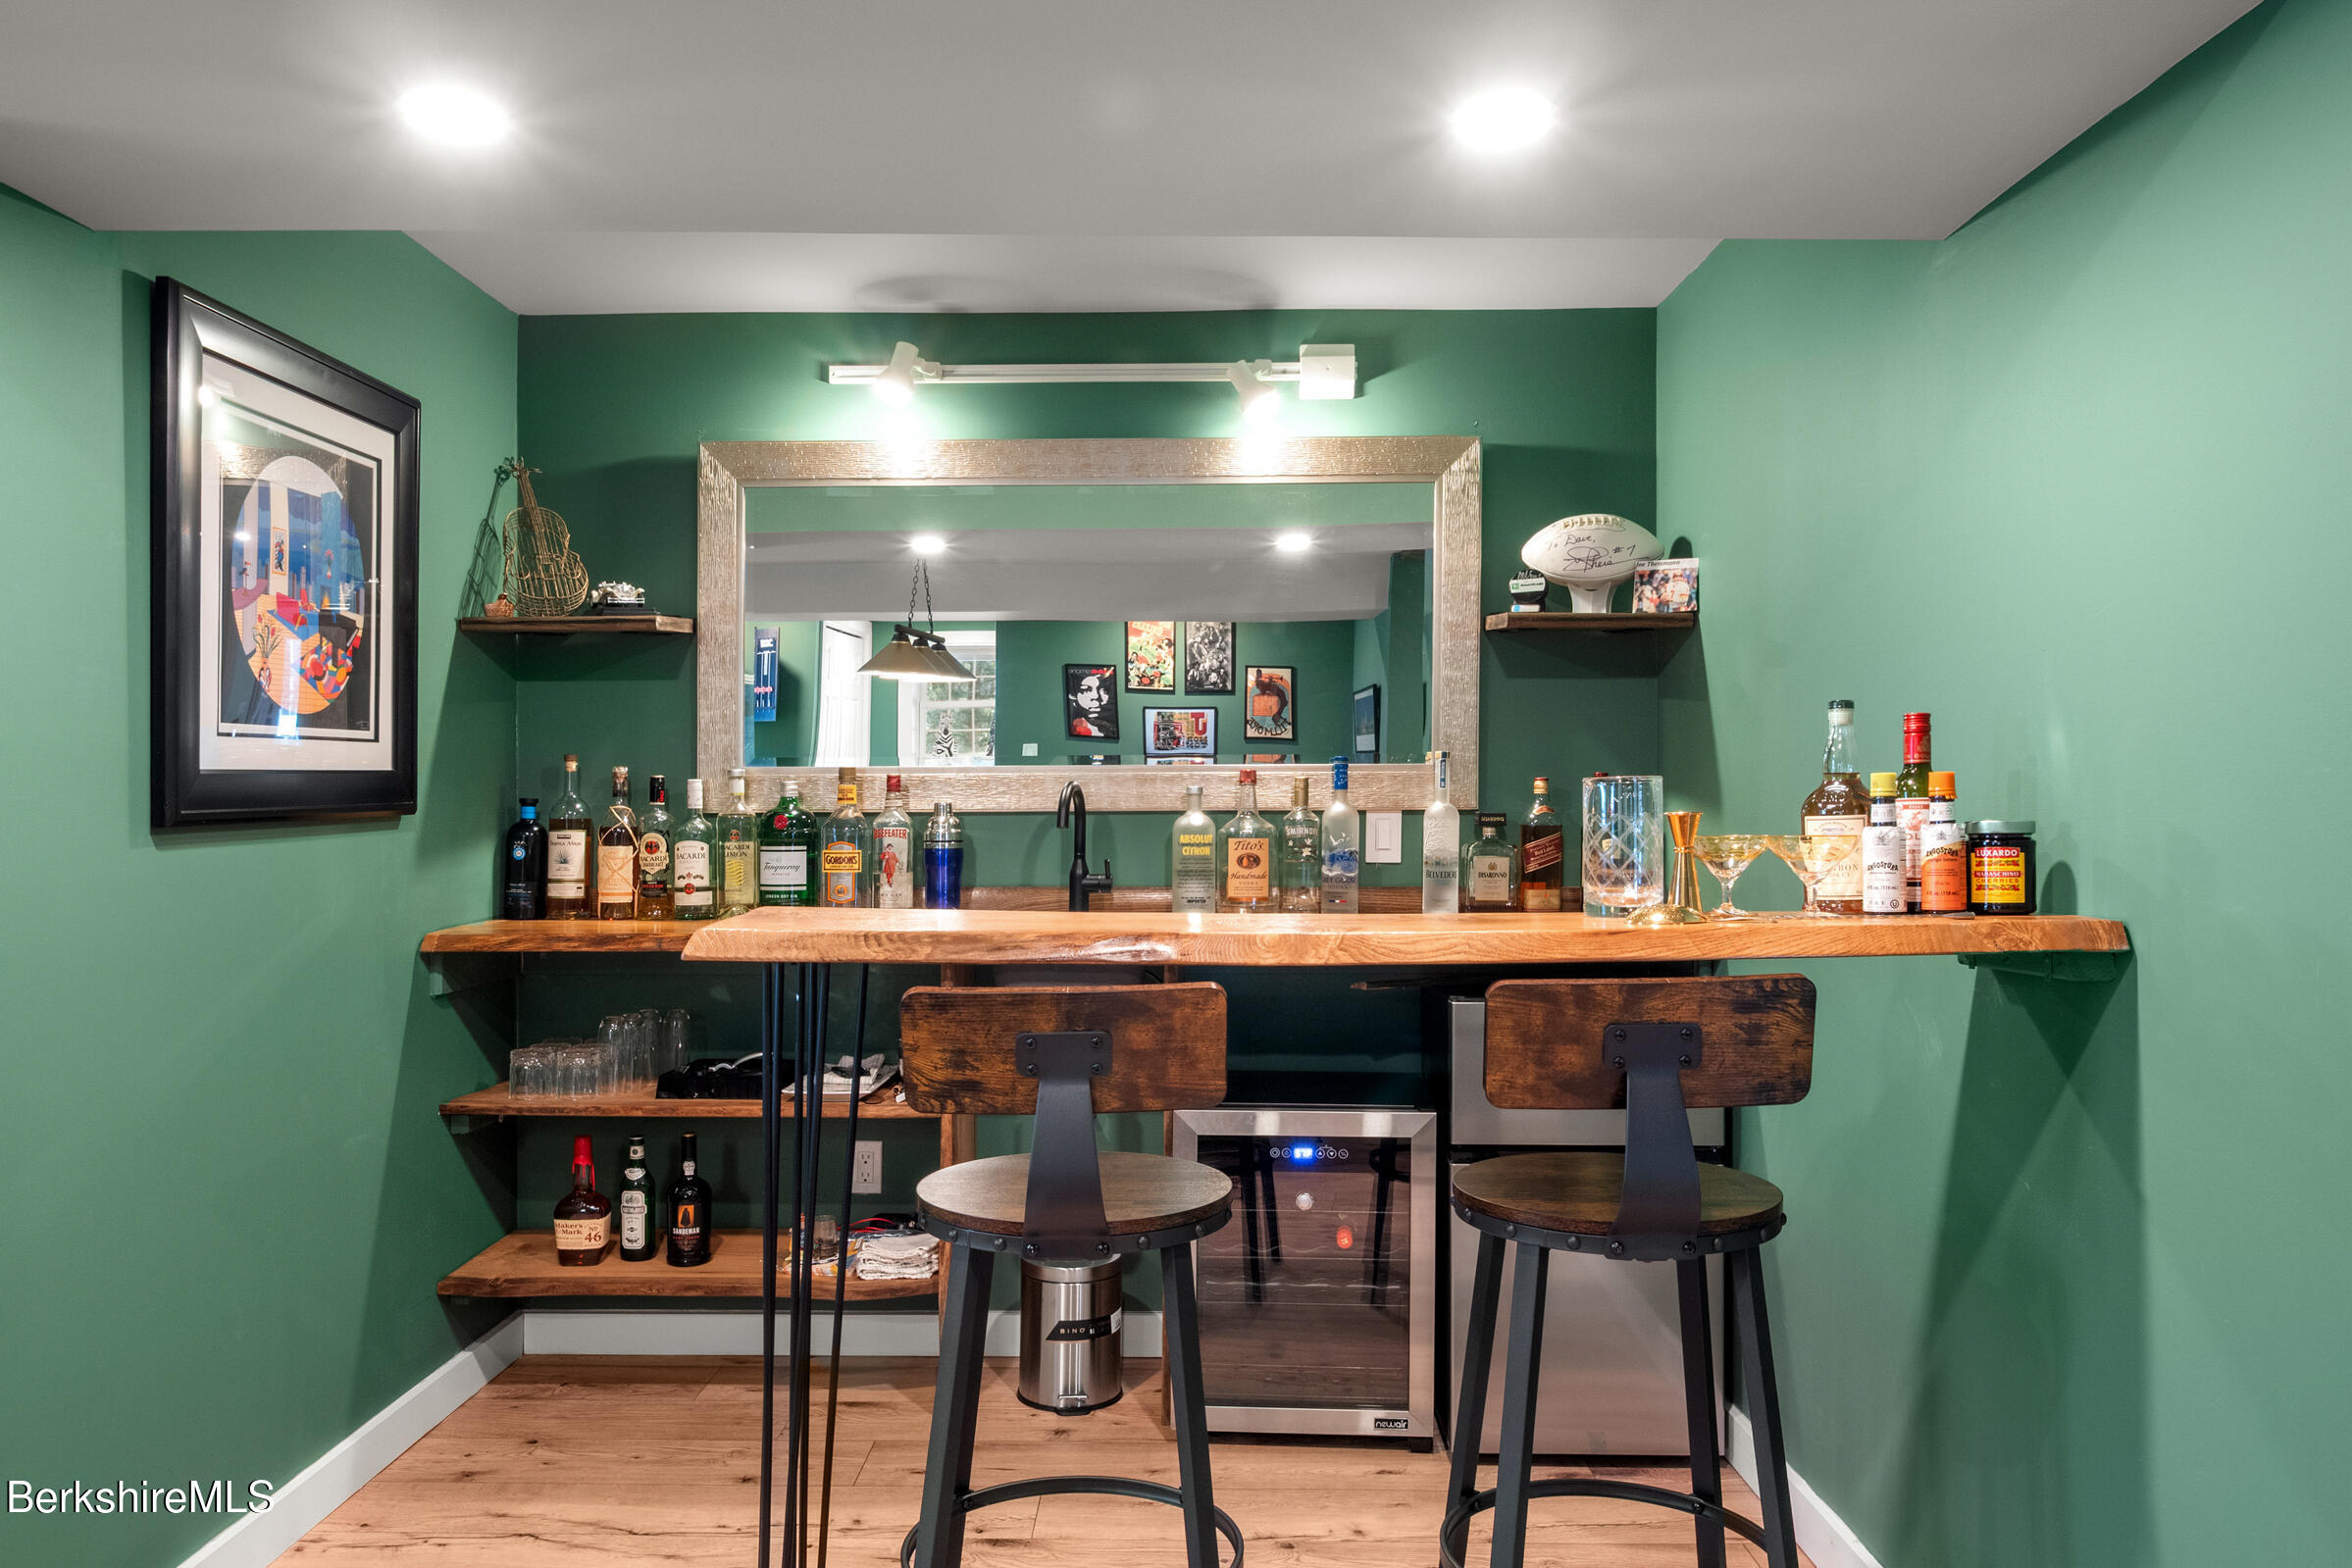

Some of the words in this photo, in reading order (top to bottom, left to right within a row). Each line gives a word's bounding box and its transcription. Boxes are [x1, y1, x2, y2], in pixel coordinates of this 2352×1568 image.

[1564, 534, 1596, 546] Dave,
[873, 829, 907, 840] BEEFEATER
[1179, 834, 1213, 844] ABSOLUT
[1234, 839, 1264, 851] Tito's
[1182, 846, 1210, 856] CITRON
[1926, 847, 1959, 857] ANGOSTURA
[825, 855, 858, 865] GORDON'S
[763, 862, 800, 873] Tanqueray
[1867, 861, 1899, 872] ANGOSTURA
[1230, 870, 1267, 880] Handmade
[585, 1232, 601, 1242] 46
